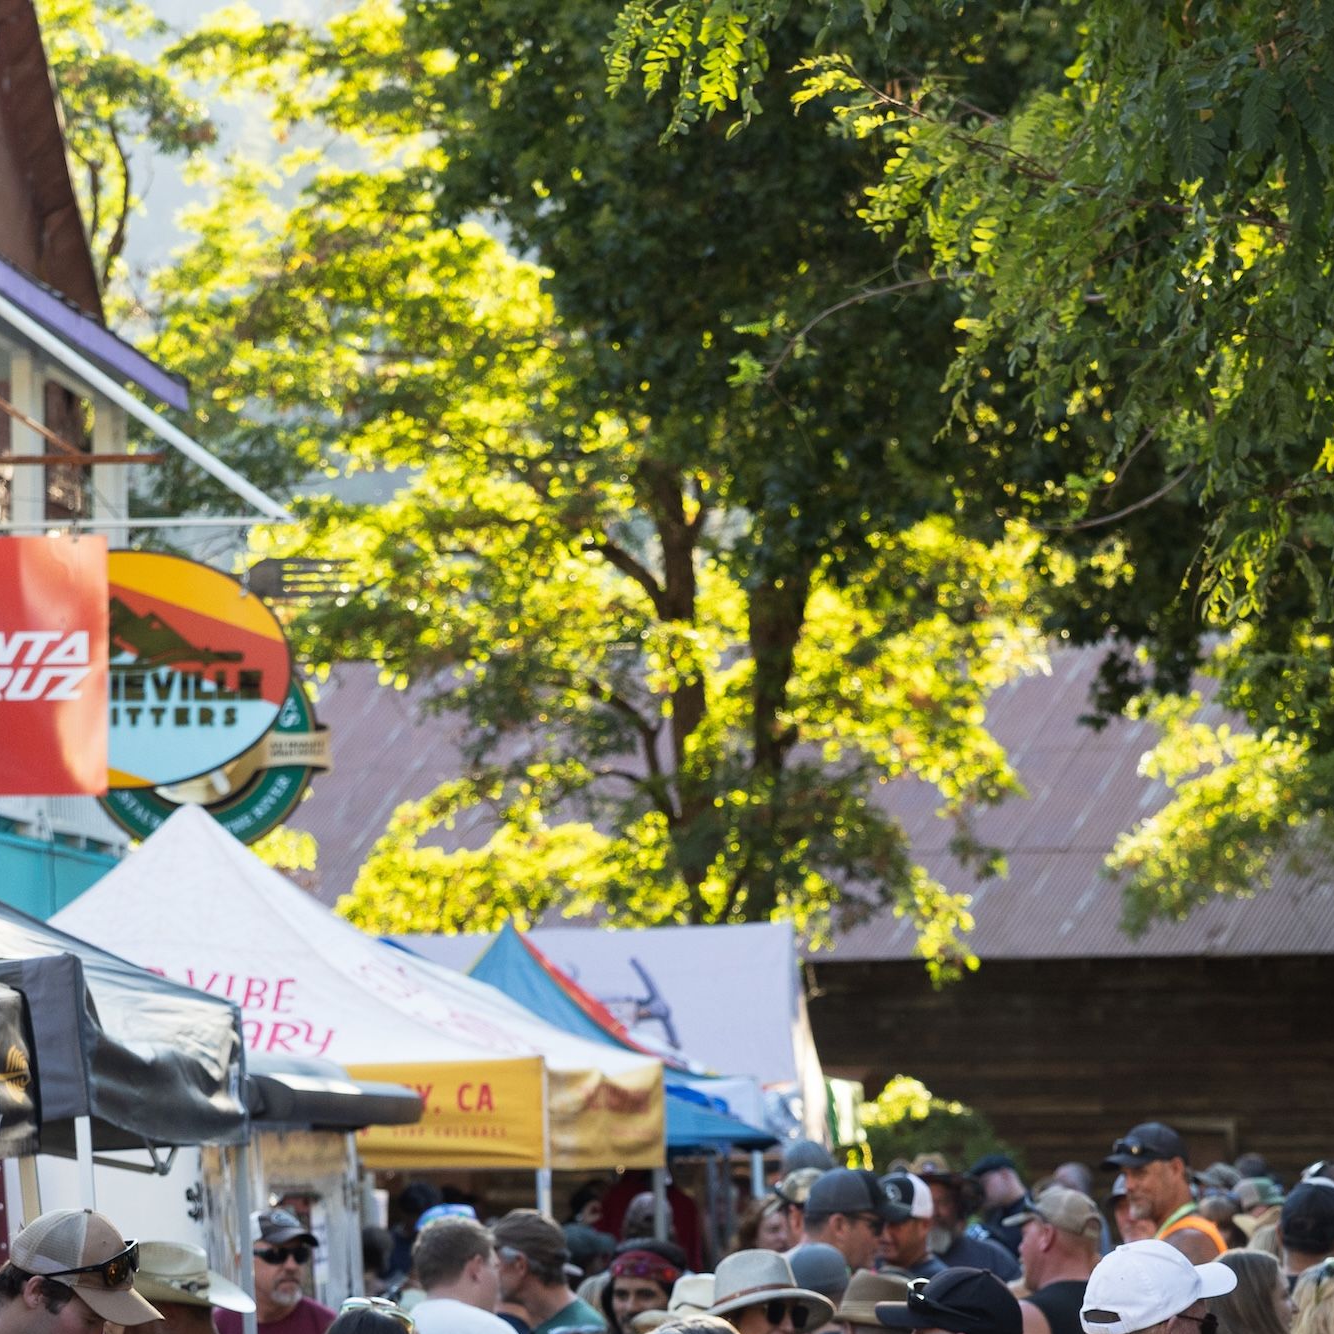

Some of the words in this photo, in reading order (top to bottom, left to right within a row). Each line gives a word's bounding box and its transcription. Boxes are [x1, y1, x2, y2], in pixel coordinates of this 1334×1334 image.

[110, 671, 263, 700] IEVILLE
[110, 707, 238, 727] ITTERS
[187, 968, 296, 1014] VIBE
[241, 1019, 336, 1058] ARY
[457, 1082, 494, 1112] CA
